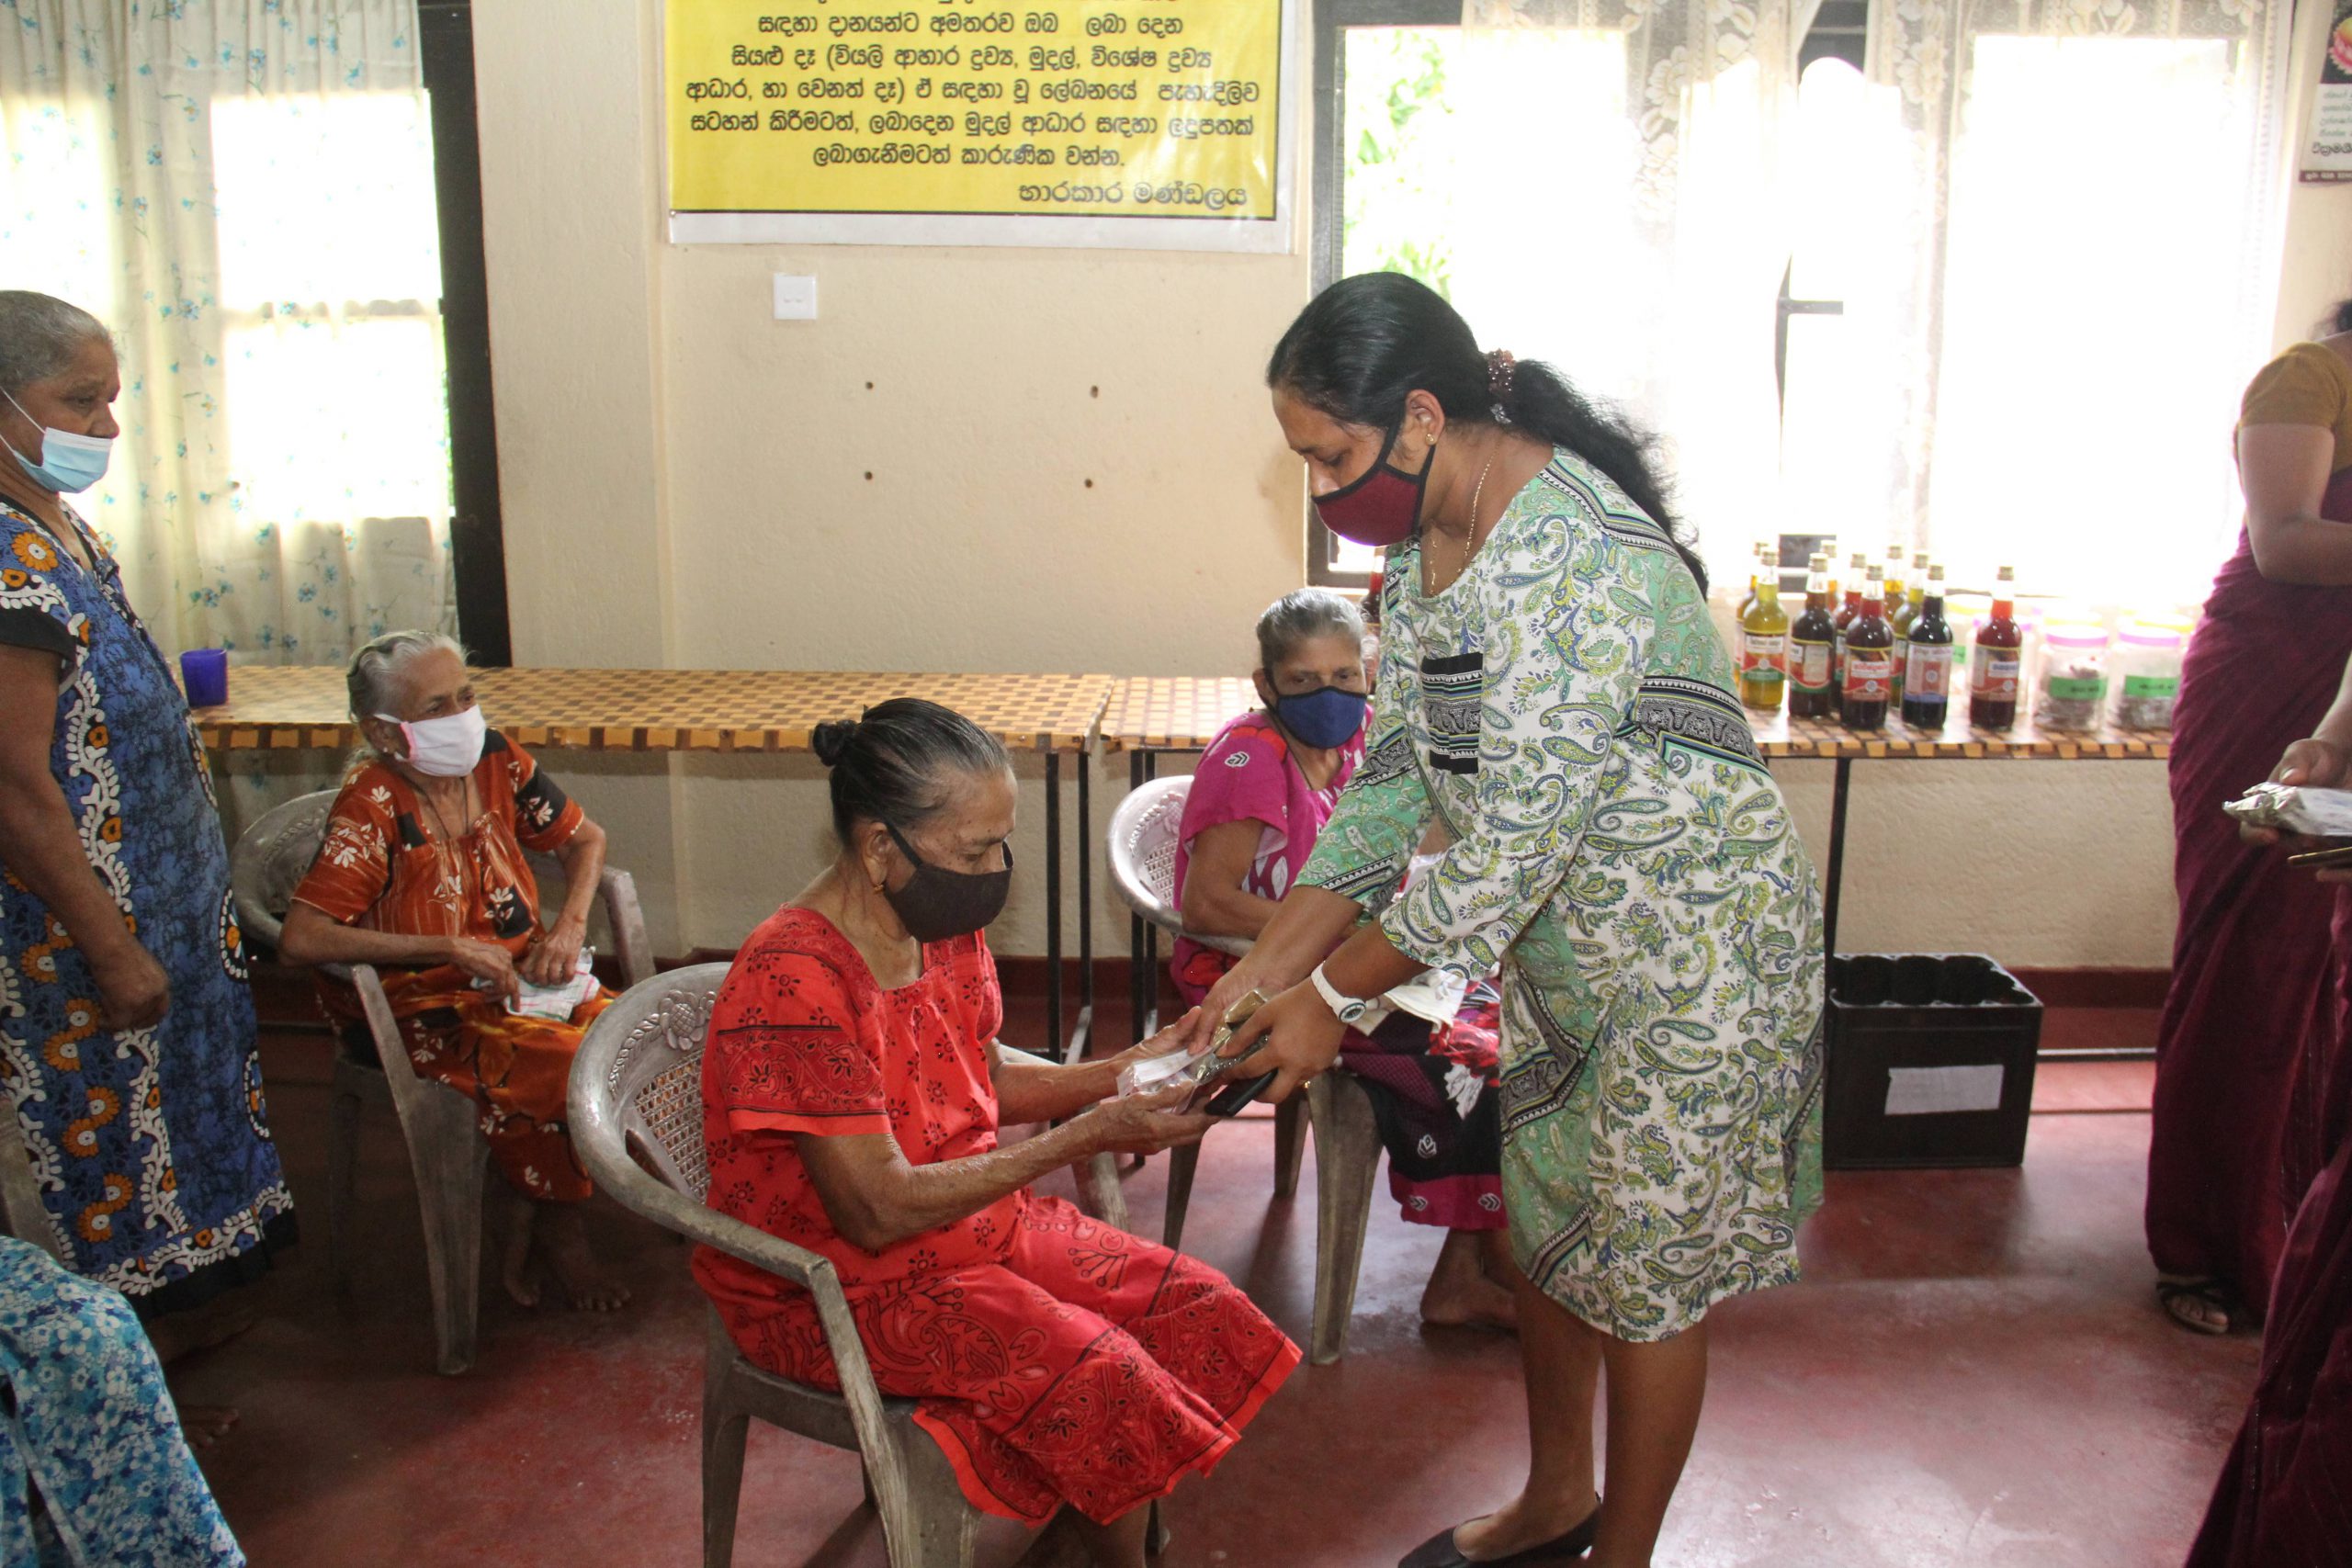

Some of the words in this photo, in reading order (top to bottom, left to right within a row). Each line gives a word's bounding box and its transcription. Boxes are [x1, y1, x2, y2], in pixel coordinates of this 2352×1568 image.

[758, 16, 818, 37] සඳහා
[828, 12, 920, 37] දානයන්ට
[930, 12, 1014, 37] අමතරව
[1024, 12, 1058, 33] ඔබ
[1085, 13, 1126, 37] ලබා
[1137, 17, 1183, 39] දෙන
[731, 44, 785, 66] සියළු
[826, 44, 884, 72] (වියලි
[894, 44, 960, 70] ආහාර
[1028, 45, 1080, 72] මුදල්,
[1091, 45, 1158, 68] විශේෂ
[685, 78, 752, 103] ආධාර,
[763, 82, 787, 99] හා
[797, 78, 864, 99] වෙනත්
[942, 82, 1003, 103] සඳහා
[1013, 79, 1030, 104] වූ
[690, 110, 759, 131] සටහන්
[868, 110, 955, 136] ලබාදෙන
[965, 111, 1012, 136] මුදල්
[1022, 111, 1086, 136] ආධාර
[1096, 116, 1158, 138] සඳහා
[1066, 144, 1125, 166] වන්න.
